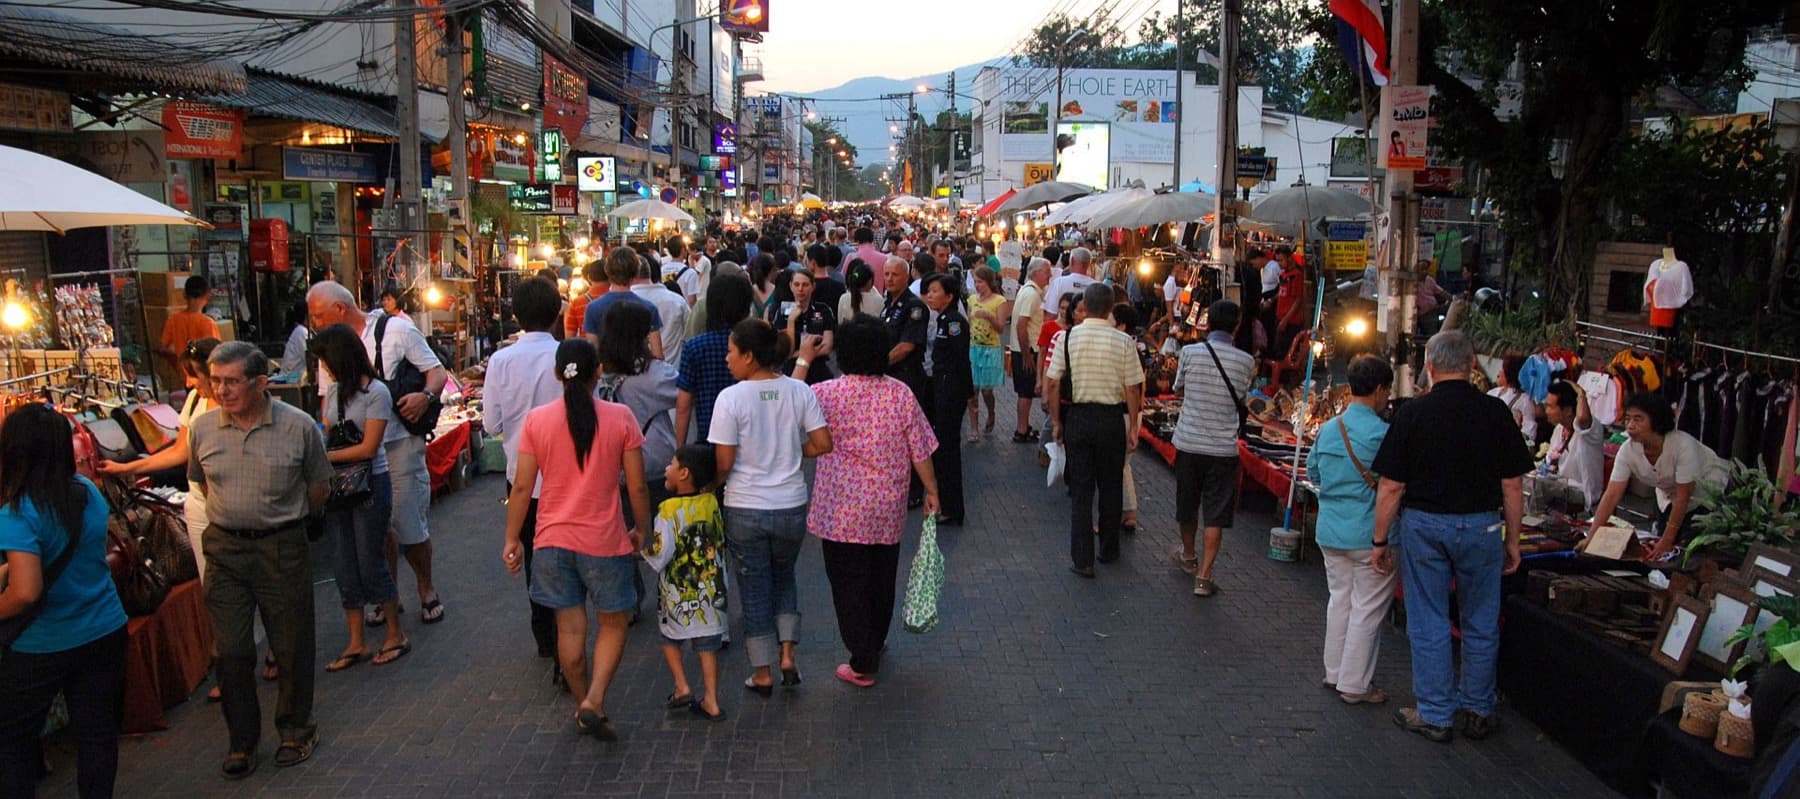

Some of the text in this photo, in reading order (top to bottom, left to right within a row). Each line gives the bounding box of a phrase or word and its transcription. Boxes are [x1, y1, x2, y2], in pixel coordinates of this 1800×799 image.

[1004, 76, 1177, 97] THE WHOLE EARTH
